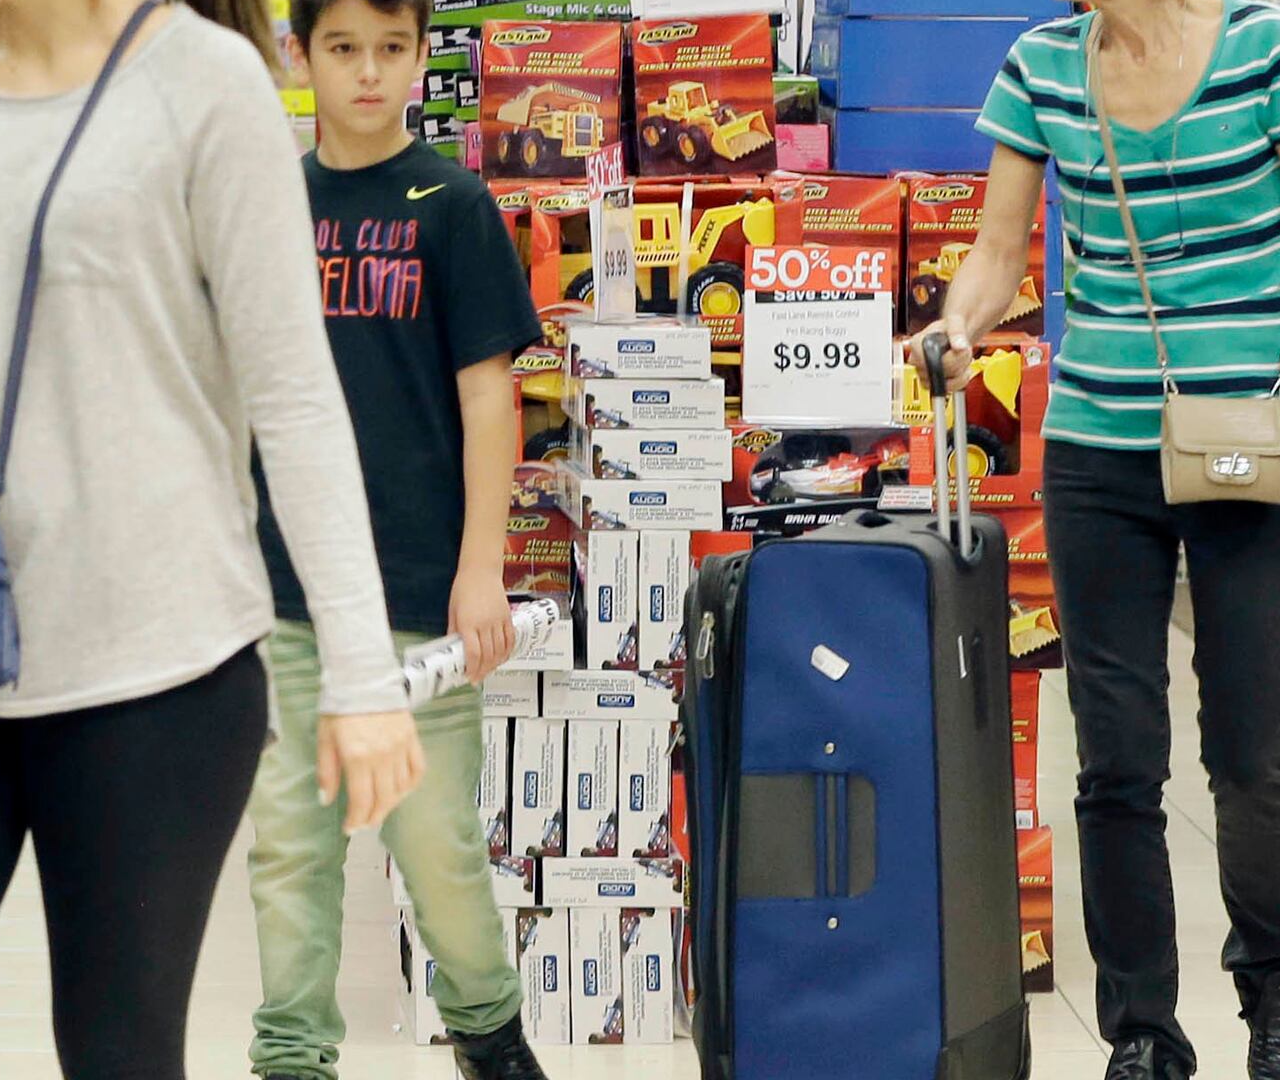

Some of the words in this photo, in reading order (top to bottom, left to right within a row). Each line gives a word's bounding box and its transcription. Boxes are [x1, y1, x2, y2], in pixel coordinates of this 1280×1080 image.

[526, 4, 563, 16] Stage
[566, 3, 590, 15] Mic
[593, 4, 604, 15] &
[608, 3, 633, 15] Gui
[802, 222, 863, 231] RANSPORTADOR
[356, 218, 420, 253] CLUB
[750, 248, 830, 289] 50%
[830, 251, 886, 290] off
[317, 255, 423, 320] ELONA
[774, 290, 816, 302] Save
[621, 343, 653, 353] AUDIO
[513, 355, 562, 369] STLANE
[774, 340, 861, 374] $9.98
[635, 394, 668, 404] AUDIO
[643, 445, 676, 455] AUDIO
[632, 495, 665, 505] AUDIO
